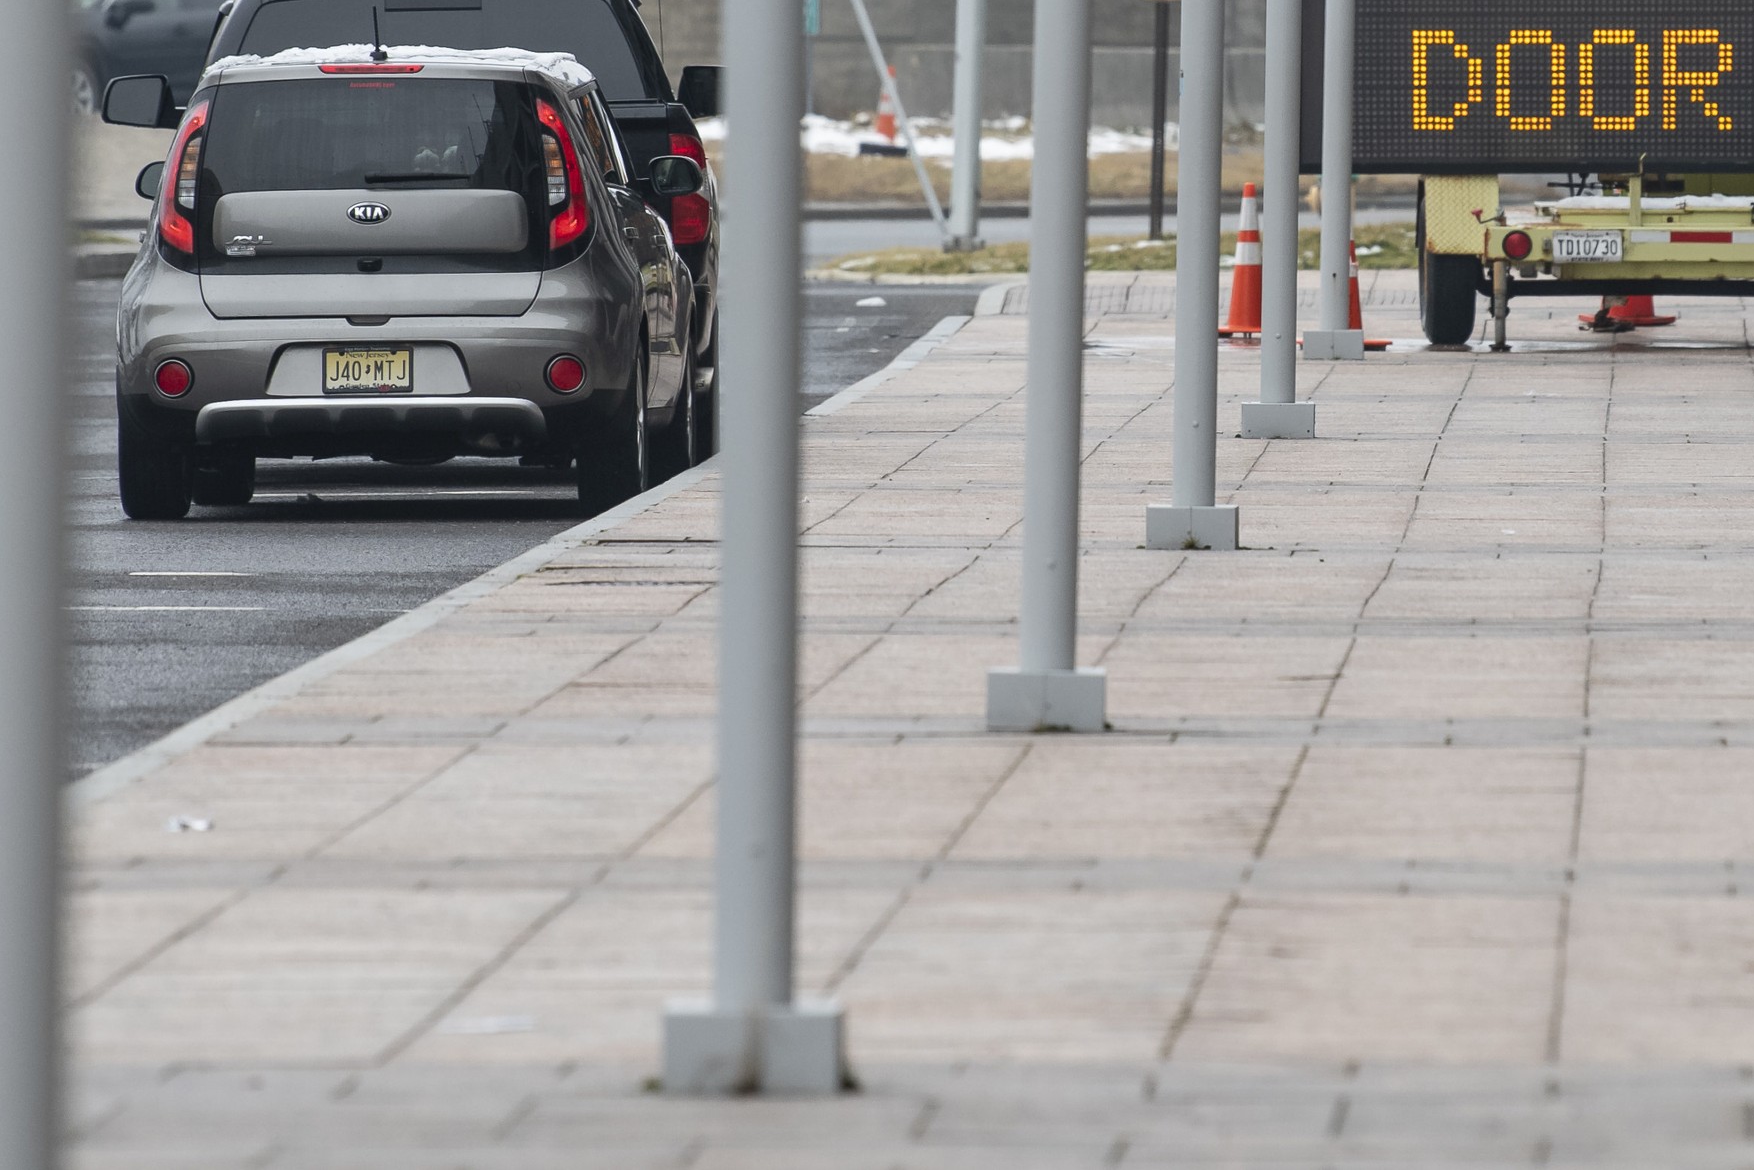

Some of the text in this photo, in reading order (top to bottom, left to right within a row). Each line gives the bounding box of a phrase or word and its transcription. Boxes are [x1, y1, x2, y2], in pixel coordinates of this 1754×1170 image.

[1412, 29, 1733, 131] DOOR
[353, 206, 384, 220] KIA
[1557, 239, 1618, 256] TD10730
[345, 351, 389, 360] New Jersey
[329, 360, 362, 382] J40
